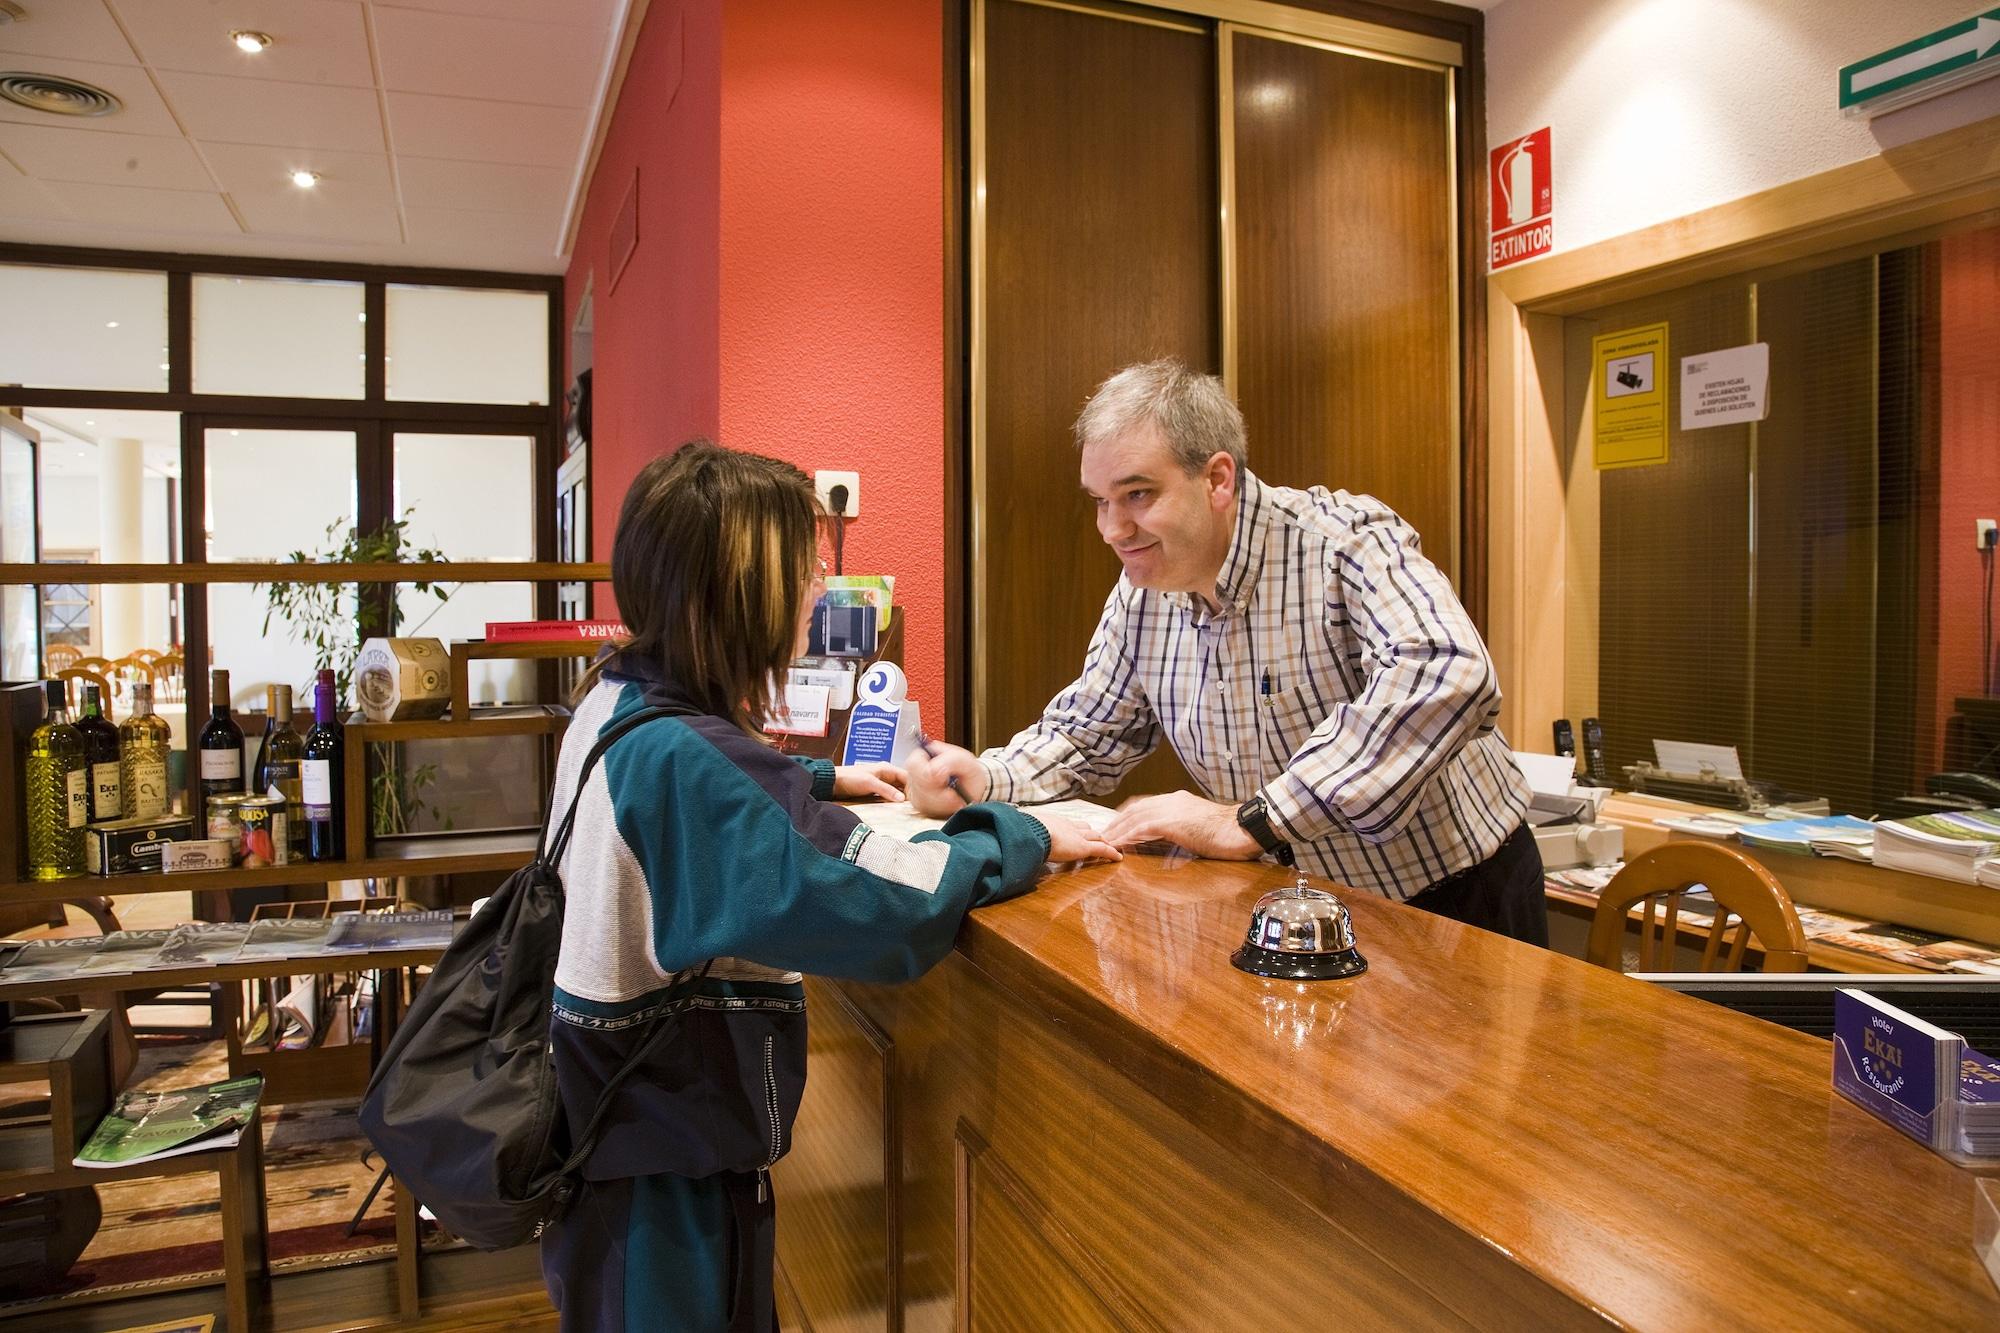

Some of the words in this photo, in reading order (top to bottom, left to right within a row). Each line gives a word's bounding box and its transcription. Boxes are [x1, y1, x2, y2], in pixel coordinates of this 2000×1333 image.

[1492, 225, 1552, 262] EXTINTOR
[790, 710, 819, 719] navarra
[134, 843, 162, 854] Camb
[844, 829, 865, 861] ASTORE
[260, 918, 324, 929] Aves
[27, 936, 104, 948] Aves
[762, 1000, 790, 1010] ASTORE
[558, 1009, 584, 1025] ASTORE
[1871, 1015, 1894, 1036] Hotel
[1861, 1056, 1905, 1095] Restaurante
